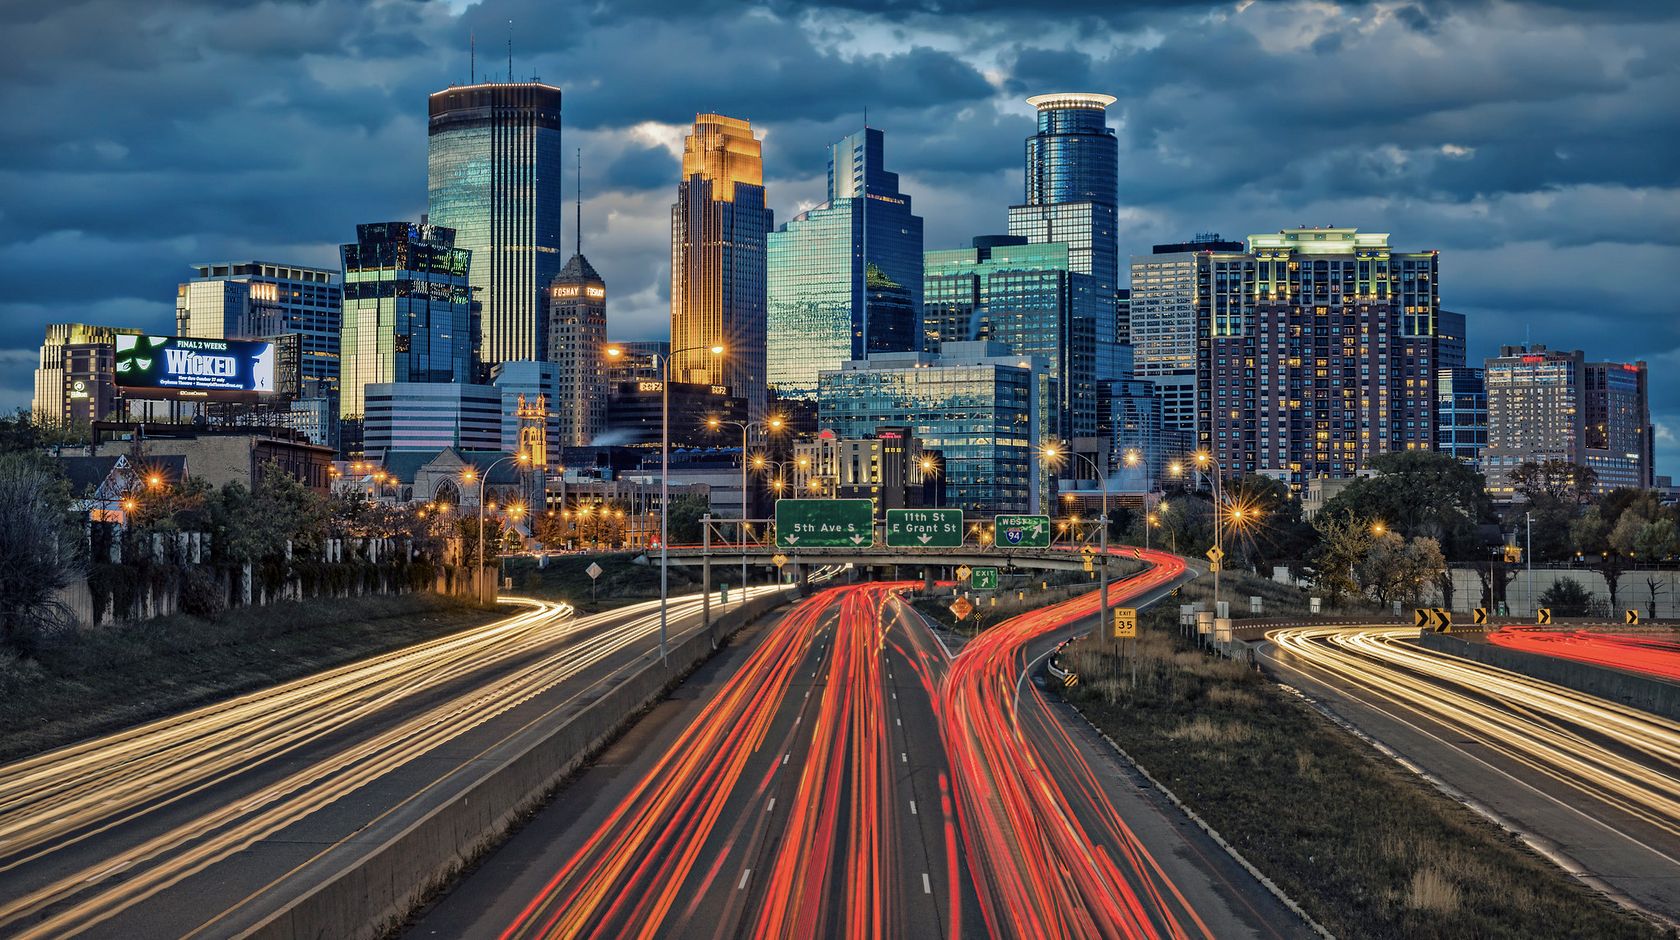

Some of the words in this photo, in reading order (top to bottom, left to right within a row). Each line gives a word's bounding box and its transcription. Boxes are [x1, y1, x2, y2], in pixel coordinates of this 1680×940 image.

[553, 287, 579, 297] FOSHAY
[177, 341, 197, 349] FINAL
[198, 341, 203, 349] 2
[203, 342, 227, 350] WEEKS
[904, 512, 927, 522] 11th
[932, 512, 945, 522] St
[1002, 518, 1027, 526] WEST
[794, 523, 815, 532] 5th
[820, 523, 842, 532] Ave
[847, 523, 855, 532] S
[893, 523, 900, 533] E
[906, 523, 938, 533] Grant
[944, 523, 957, 533] St
[1008, 531, 1020, 540] 94
[1118, 620, 1133, 630] 35
